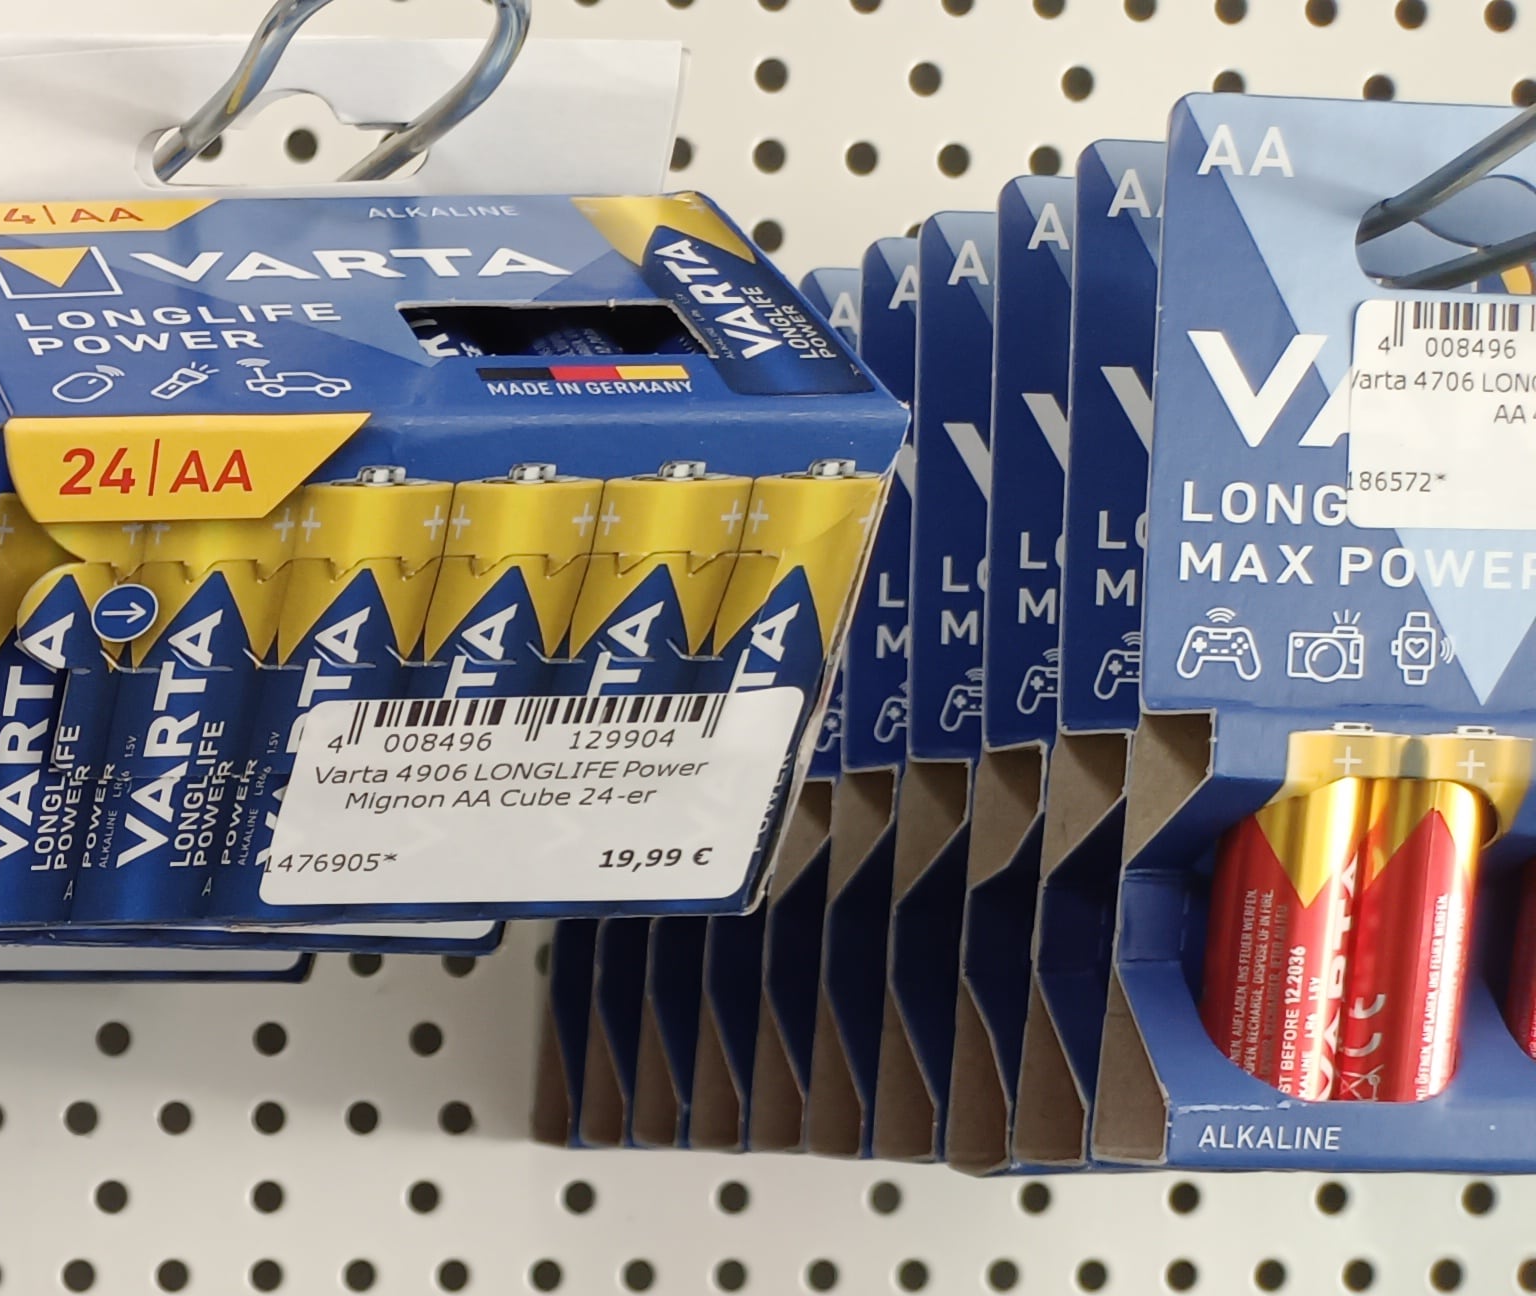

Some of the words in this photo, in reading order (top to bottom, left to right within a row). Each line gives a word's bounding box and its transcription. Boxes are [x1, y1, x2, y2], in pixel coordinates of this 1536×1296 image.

[1197, 124, 1295, 179] AA
[368, 205, 519, 220] ALKALINE
[130, 247, 573, 281] VARTA
[653, 239, 781, 359] VARTA
[15, 303, 341, 331] LONGLIFE
[28, 329, 265, 356] POWER
[1425, 337, 1516, 359] 008496
[487, 381, 551, 397] MADE
[557, 381, 580, 396] IN
[586, 379, 693, 396] GERMANY
[1413, 371, 1474, 392] 4706
[1494, 404, 1526, 424] AA
[1180, 542, 1315, 586] MAX
[384, 731, 493, 754] 008496
[568, 728, 676, 750] 129904
[314, 763, 388, 785] Varta
[395, 762, 469, 784] 4906
[474, 760, 618, 782] LONGLIFE
[621, 758, 708, 780] Power
[344, 788, 446, 813] Mignon
[452, 788, 492, 808] AA
[499, 787, 572, 808] Cube
[578, 786, 657, 806] 24-er
[598, 847, 683, 871] 19,99
[692, 846, 713, 866] €
[1284, 946, 1305, 1005] 12.2036
[1198, 1125, 1341, 1151] ALKALINE
